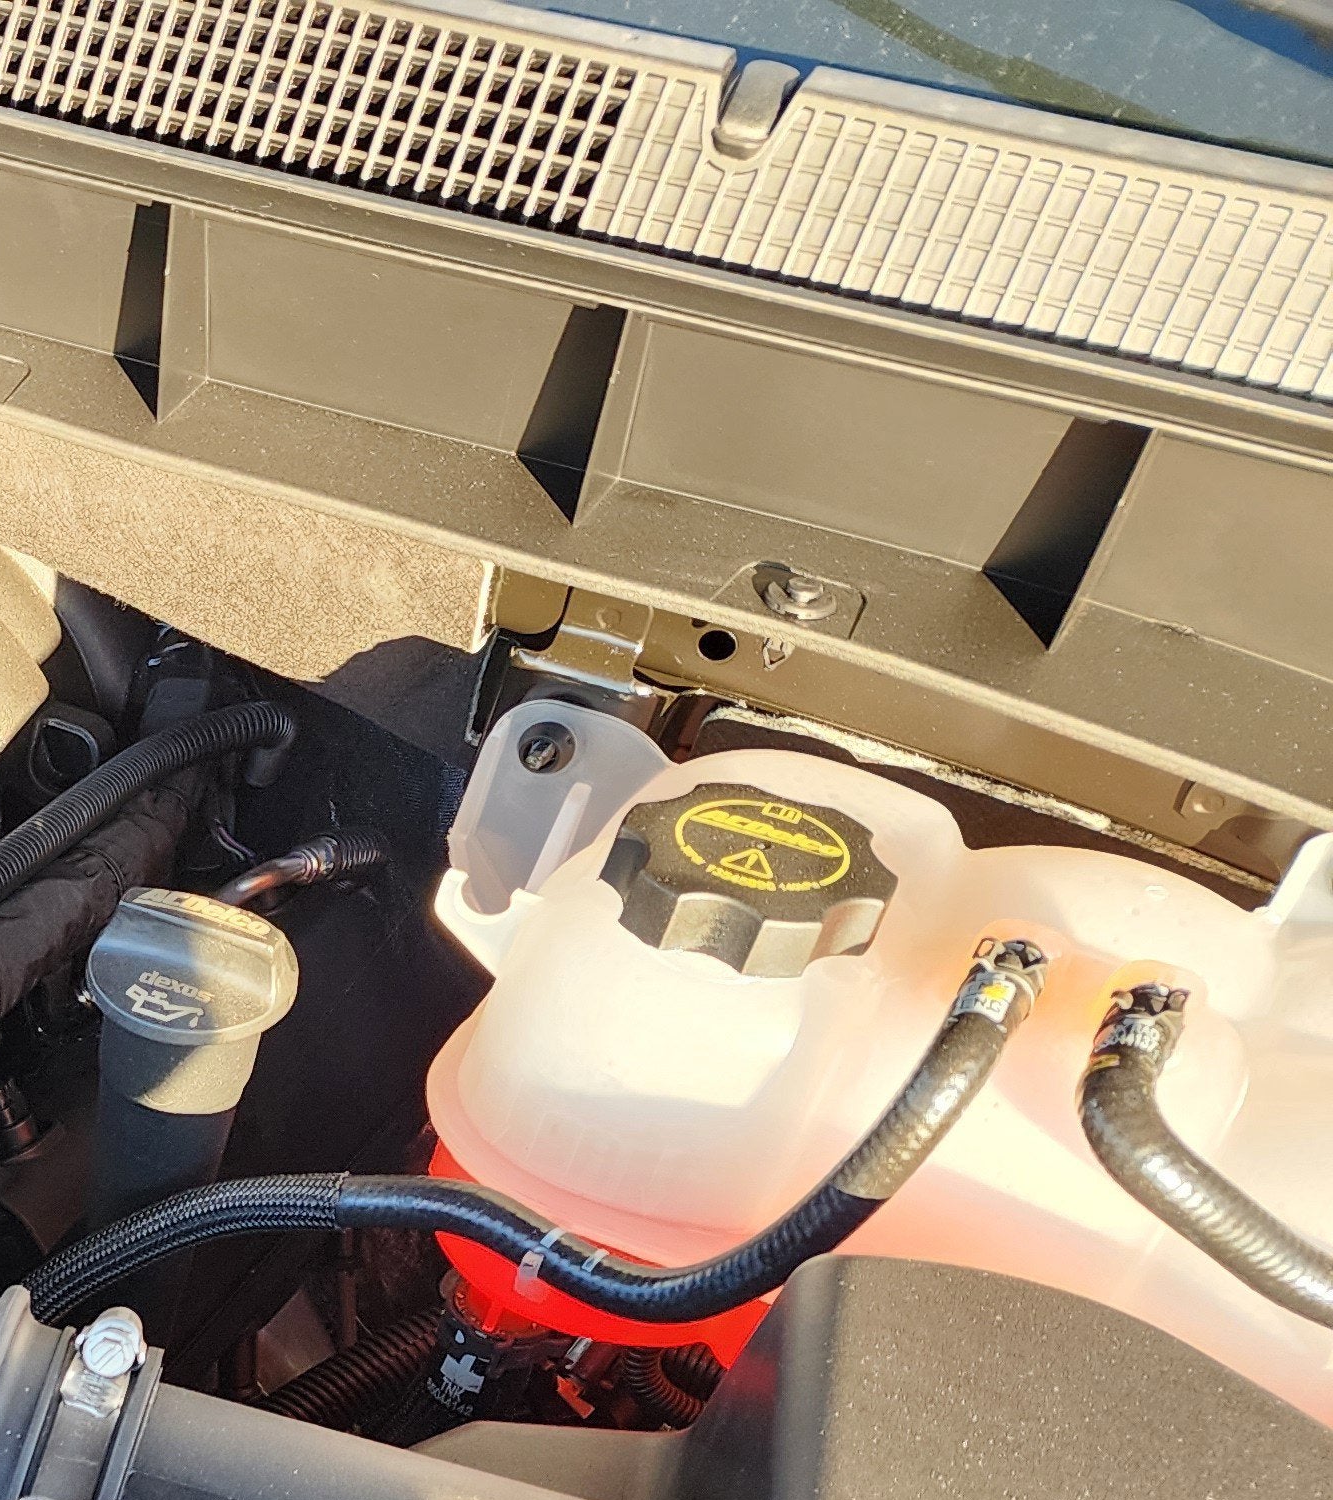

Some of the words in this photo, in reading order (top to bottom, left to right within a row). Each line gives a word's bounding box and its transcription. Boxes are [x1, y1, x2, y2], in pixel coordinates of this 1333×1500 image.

[134, 887, 272, 938] ACDelco
[138, 970, 215, 1004] dexos
[441, 1378, 465, 1399] TNK
